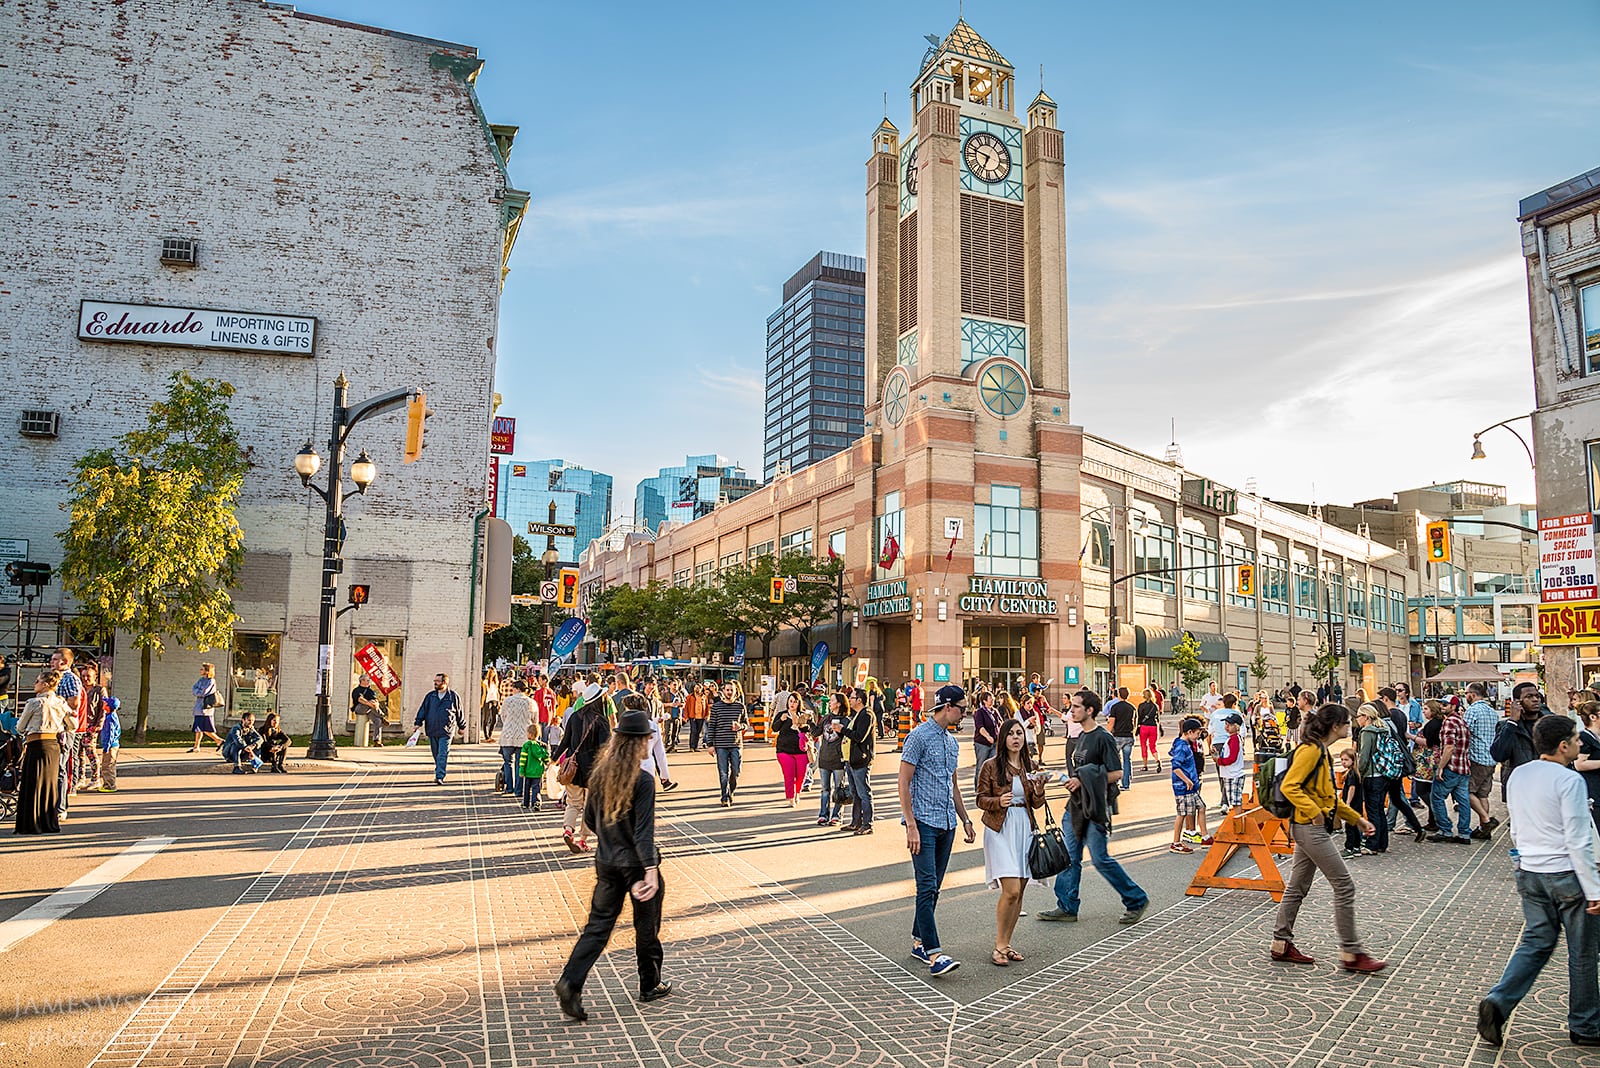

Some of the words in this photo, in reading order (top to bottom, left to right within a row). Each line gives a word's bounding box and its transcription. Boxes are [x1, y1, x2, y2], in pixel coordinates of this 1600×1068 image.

[85, 311, 204, 336] Eduardo
[216, 316, 285, 331] IMPORTING
[288, 322, 310, 333] LTD.
[211, 331, 257, 345] LINENS
[261, 335, 270, 346] &
[274, 336, 310, 348] GIFTS
[1201, 479, 1238, 515] Hart
[530, 524, 566, 535] WILSON
[1541, 519, 1560, 529] FOR
[1563, 514, 1588, 526] RENT
[1543, 527, 1587, 541] COMMERCIAL
[1553, 539, 1578, 550] SPACE/
[1542, 552, 1565, 563] ARTIST
[1567, 549, 1592, 560] STUDIO
[1559, 565, 1576, 575] 289
[867, 581, 907, 600] HAMILTON
[970, 578, 1048, 597] HAMILTON
[1546, 591, 1565, 600] FOR
[1567, 589, 1593, 599] RENT
[862, 601, 880, 617] CITY
[879, 597, 911, 615] CENTRE
[960, 596, 994, 612] CITY
[1000, 598, 1057, 615] CENTRE
[1539, 606, 1588, 638] CA$H
